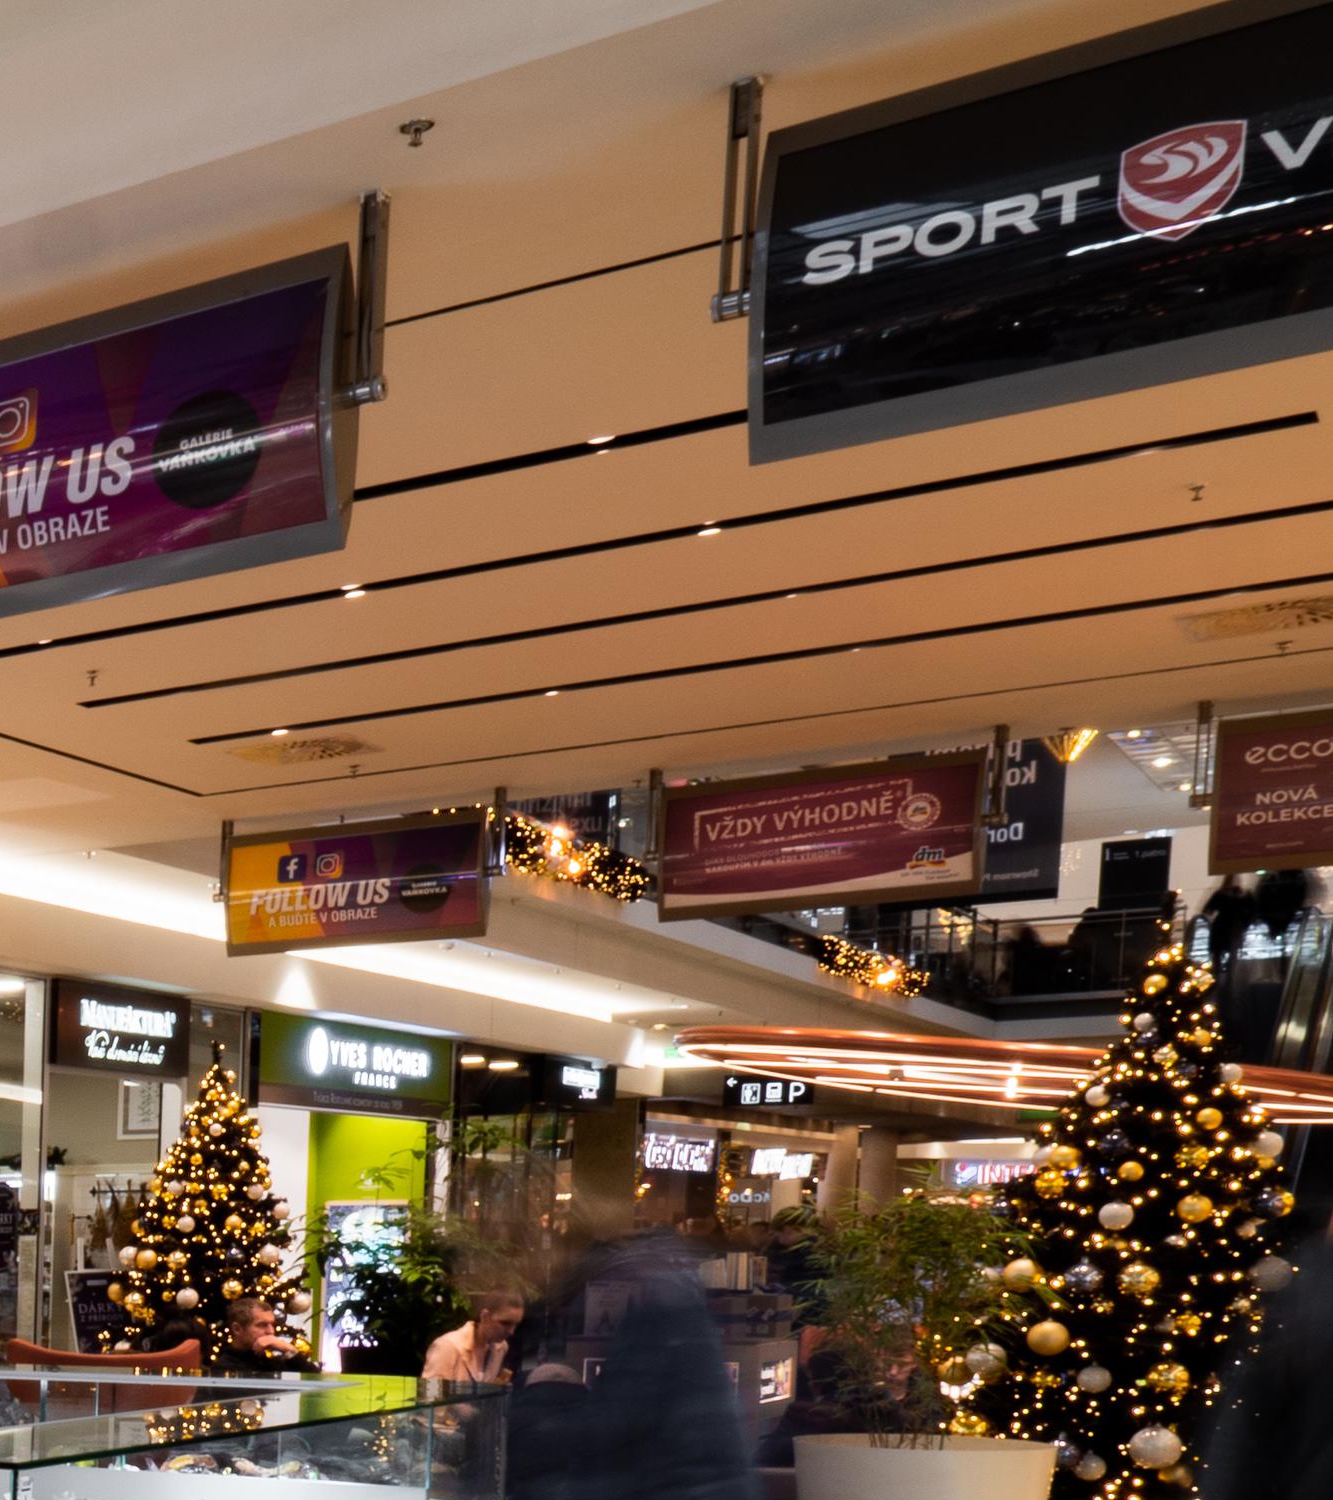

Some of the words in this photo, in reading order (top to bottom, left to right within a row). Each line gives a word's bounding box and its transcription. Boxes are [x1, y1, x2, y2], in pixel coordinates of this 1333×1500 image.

[801, 176, 1100, 285] SPORT
[180, 428, 233, 450] GALERIE
[67, 435, 136, 504] US
[17, 506, 110, 550] OBRAZE
[1245, 739, 1333, 764] ecco
[1255, 784, 1319, 806] NOVÁ
[705, 815, 767, 843] VŽDY
[774, 791, 895, 832] VÝHODNĚ
[1236, 804, 1333, 827] KOLEKCE
[249, 883, 351, 916] FOLLOW
[357, 877, 391, 905] US
[268, 917, 276, 928] A
[320, 911, 328, 923] V
[331, 906, 378, 922] OBRAZE
[330, 1040, 367, 1069] YVES
[373, 1046, 429, 1077] ROCHER
[354, 1071, 397, 1089] FRANCE
